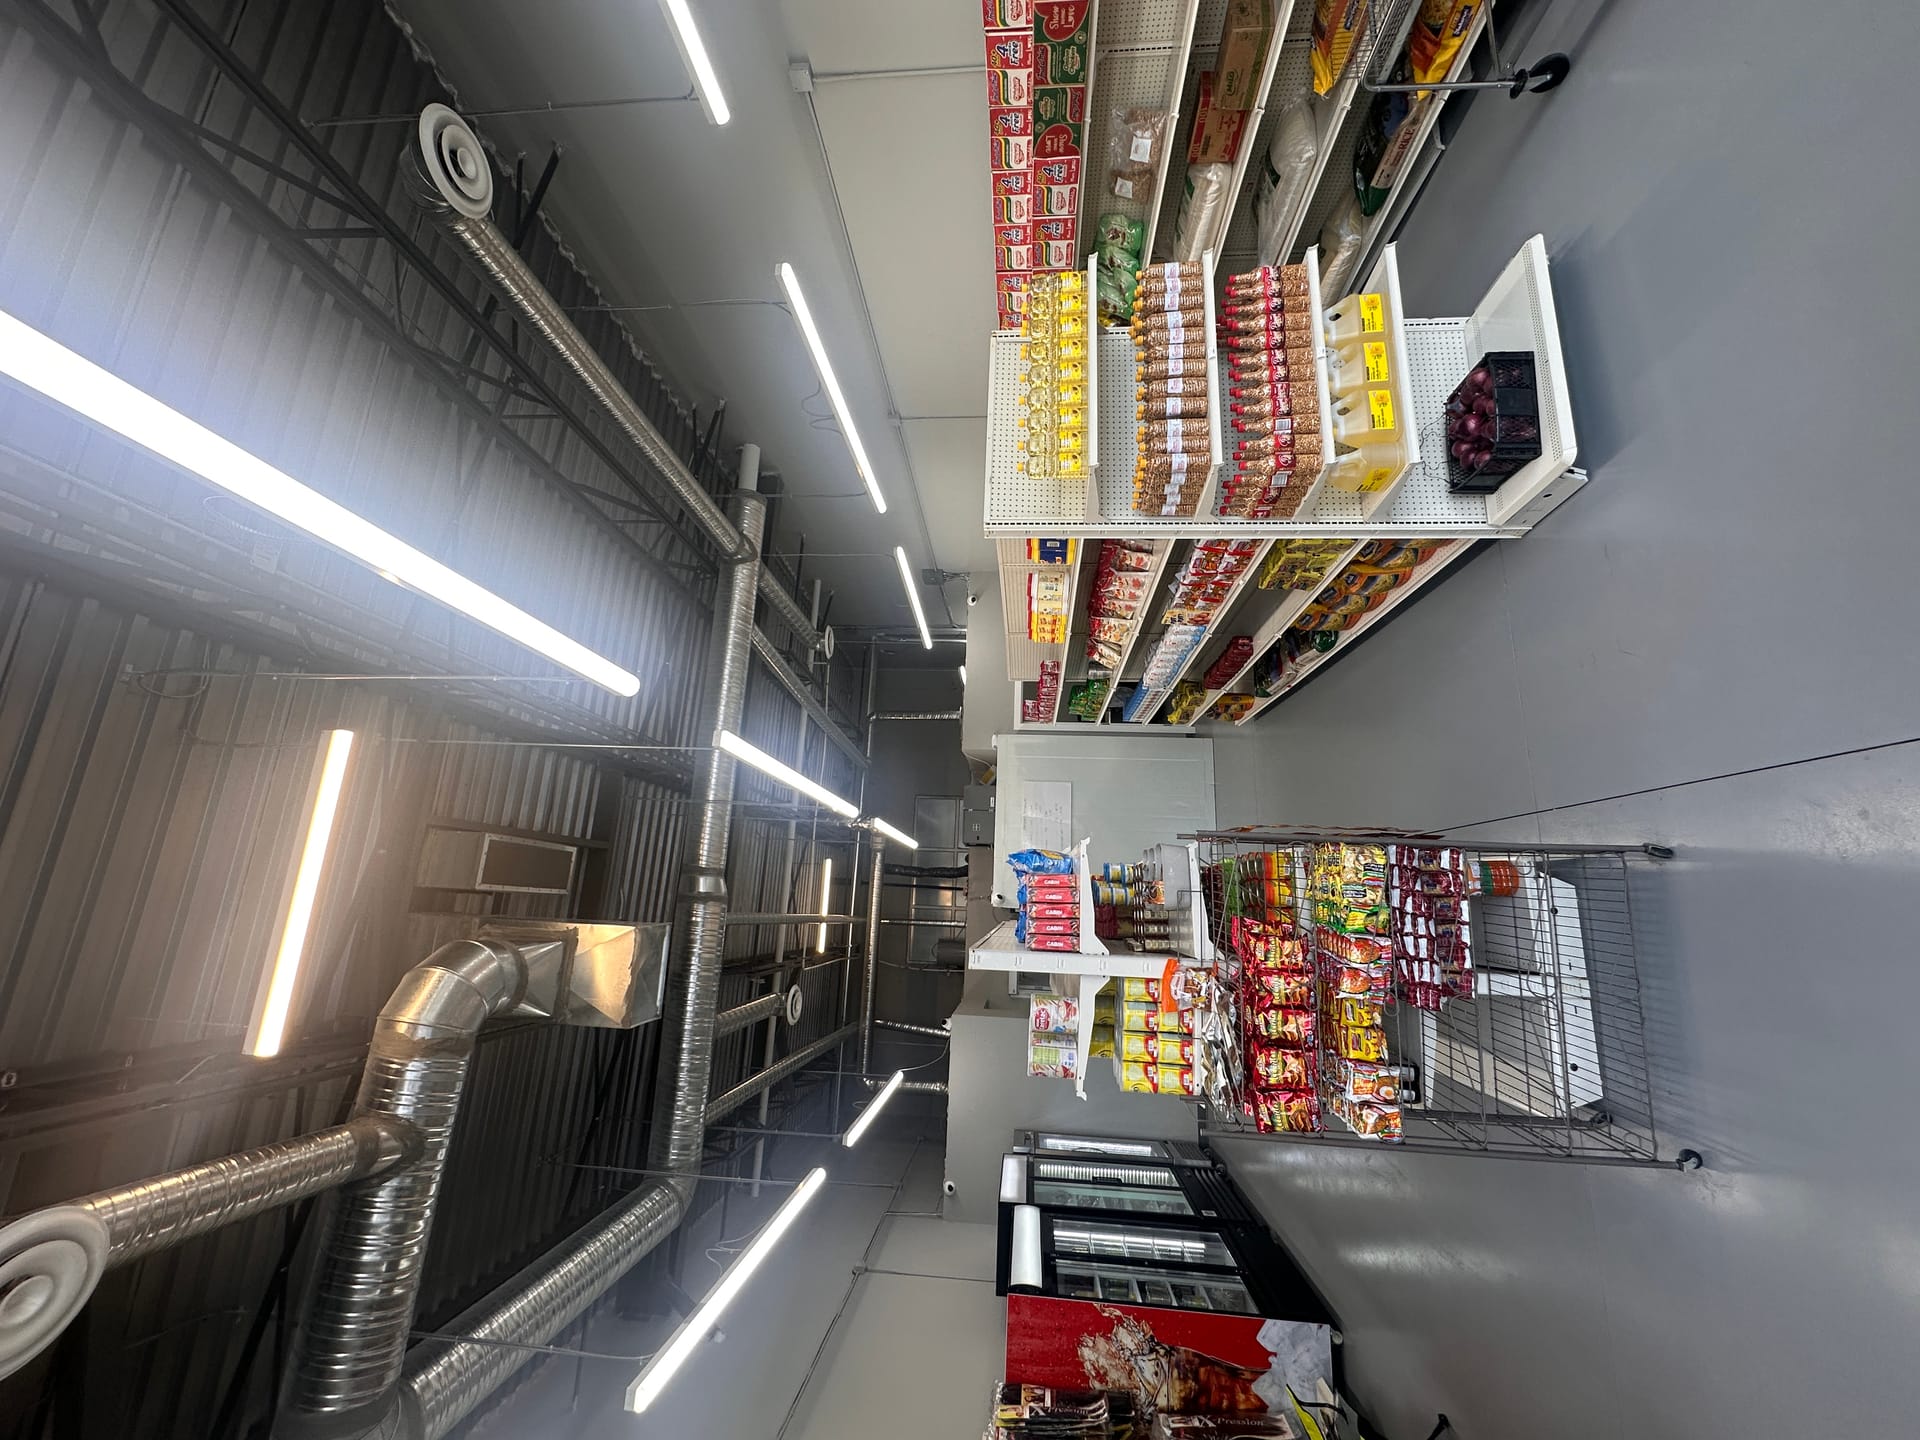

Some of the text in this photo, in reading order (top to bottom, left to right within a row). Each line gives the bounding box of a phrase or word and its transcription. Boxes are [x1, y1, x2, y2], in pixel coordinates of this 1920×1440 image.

[1050, 5, 1059, 30] Show
[1064, 4, 1075, 28] Love
[996, 46, 1008, 57] 4
[1011, 42, 1019, 65] Free
[998, 116, 1010, 127] 4
[1012, 112, 1020, 133] Free
[1398, 128, 1415, 150] RICE
[1042, 166, 1053, 176] 4
[1055, 164, 1063, 182] Free
[1001, 178, 1012, 188] 4
[1041, 224, 1051, 232] 4
